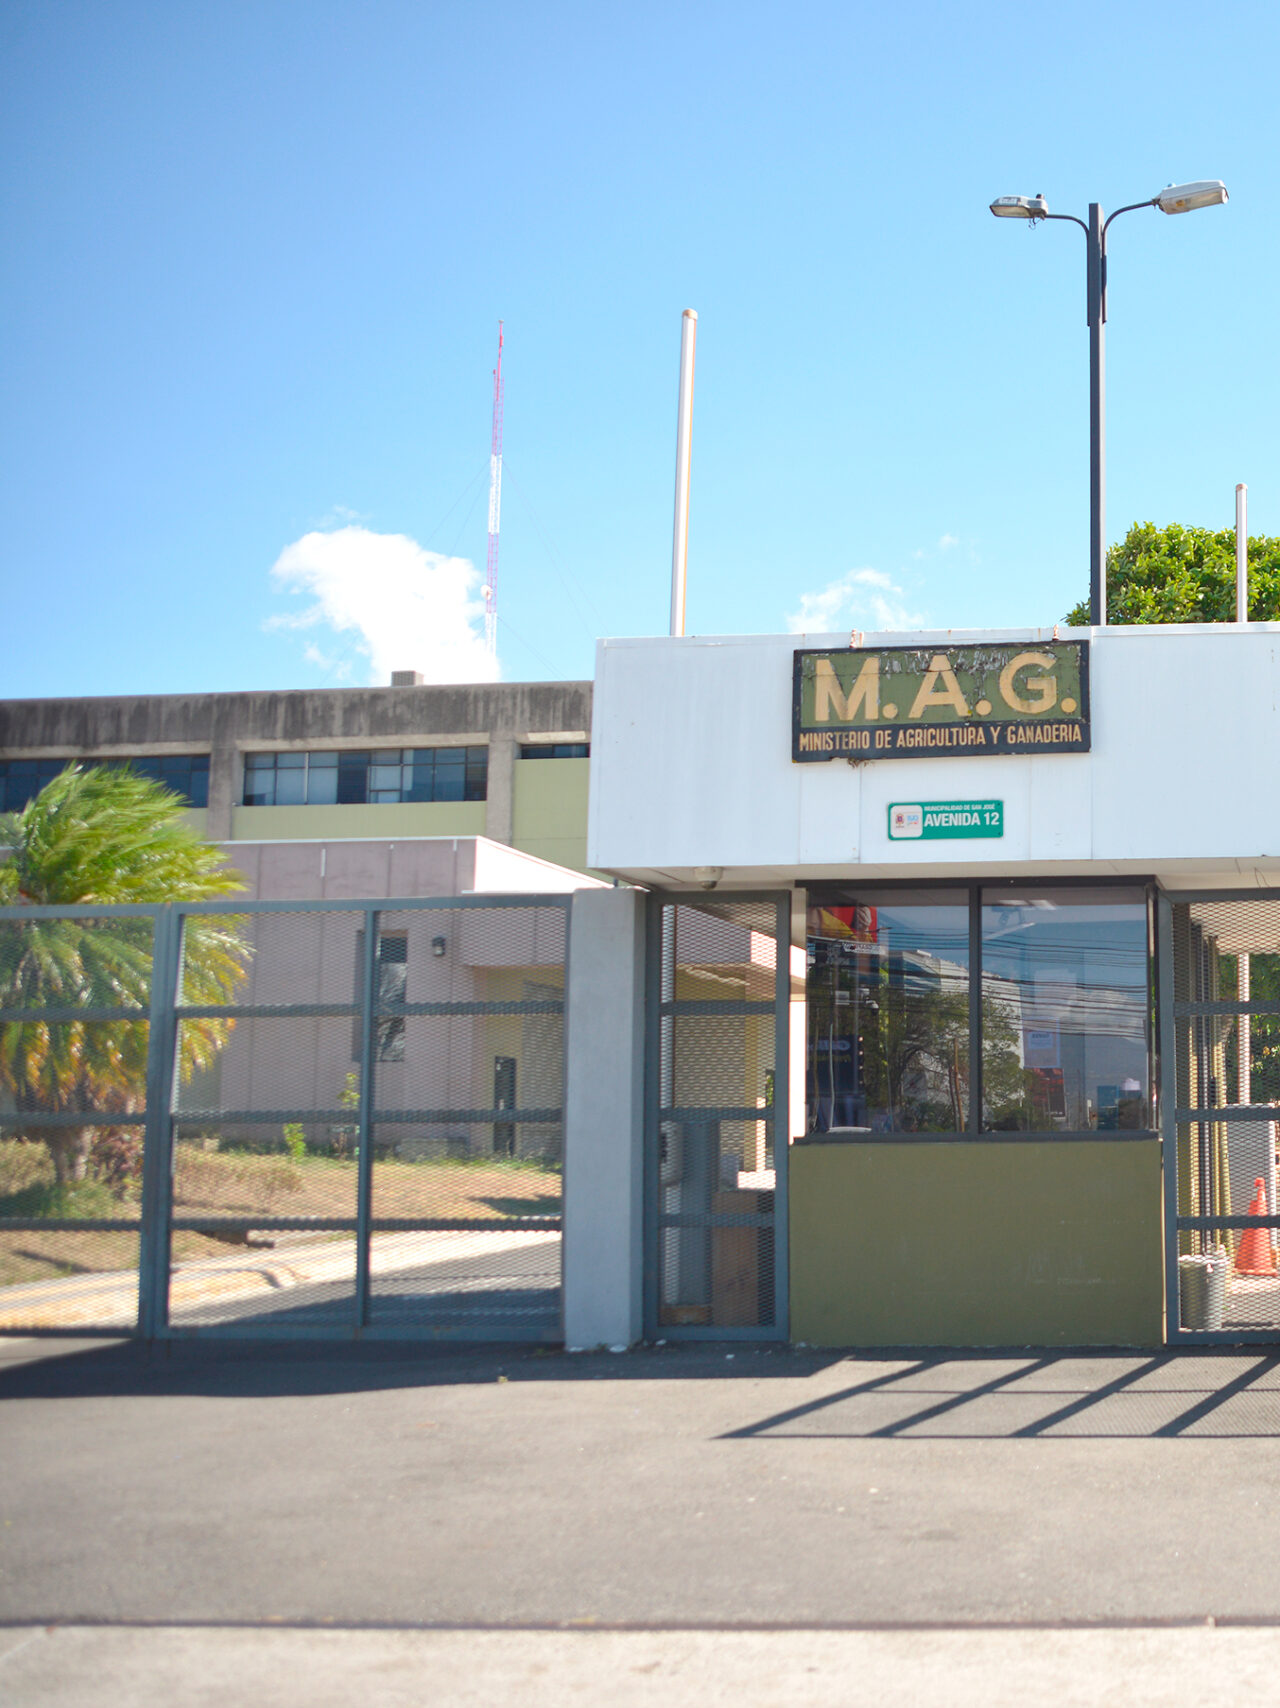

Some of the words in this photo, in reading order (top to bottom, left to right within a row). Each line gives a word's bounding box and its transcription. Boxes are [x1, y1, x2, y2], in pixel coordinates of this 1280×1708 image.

[815, 651, 1077, 721] M.A.G.
[799, 731, 870, 751] MINISTERIO
[875, 730, 892, 749] DE
[896, 726, 986, 748] AGRICULTURA
[990, 726, 1001, 744] Y
[1006, 724, 1082, 744] GANADERIA
[924, 812, 981, 827] AVENIDA
[984, 812, 1000, 826] 12
